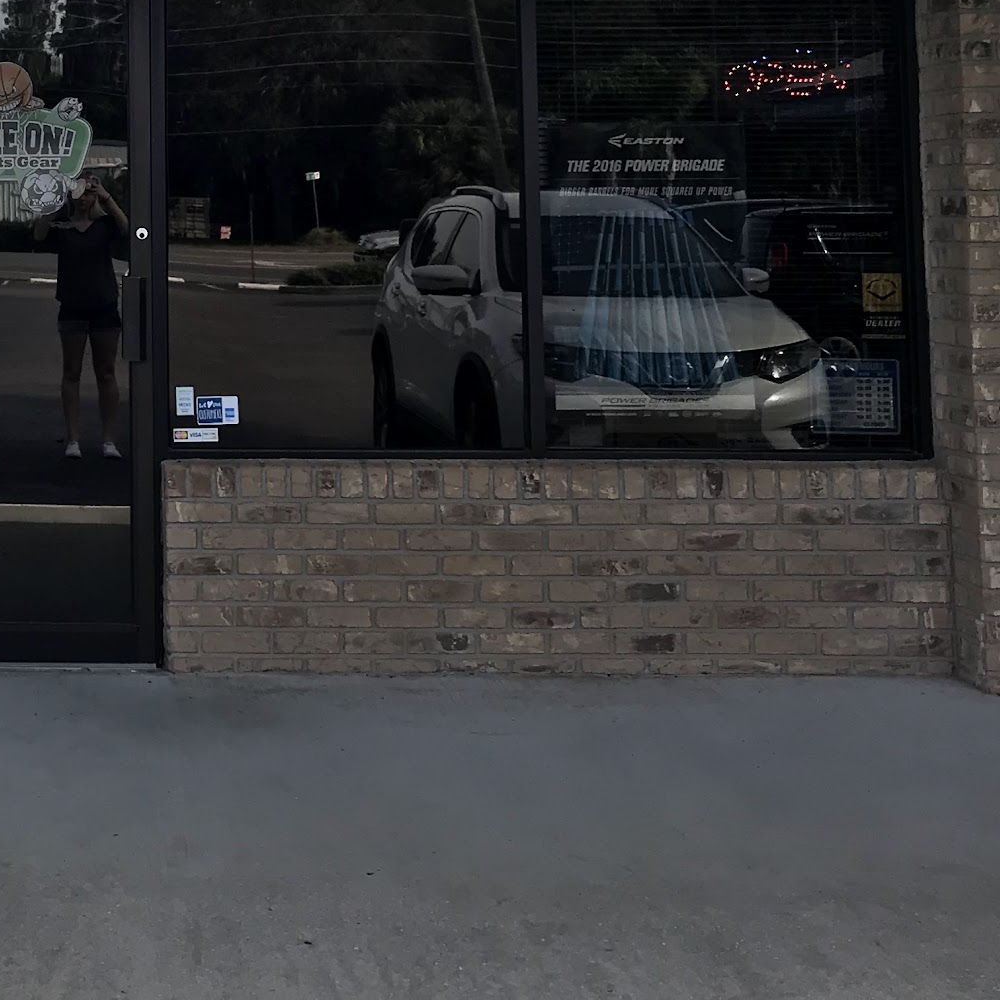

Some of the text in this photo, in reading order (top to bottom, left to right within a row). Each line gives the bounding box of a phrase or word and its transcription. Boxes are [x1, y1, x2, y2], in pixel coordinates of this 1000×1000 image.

[724, 62, 851, 96] OPEN
[25, 121, 75, 156] ON!
[623, 137, 685, 145] EASTON
[16, 157, 60, 169] Gear
[567, 159, 726, 173] THE 2016 POWER BRIGADE
[707, 186, 733, 196] POWER
[865, 319, 902, 327] DEALER
